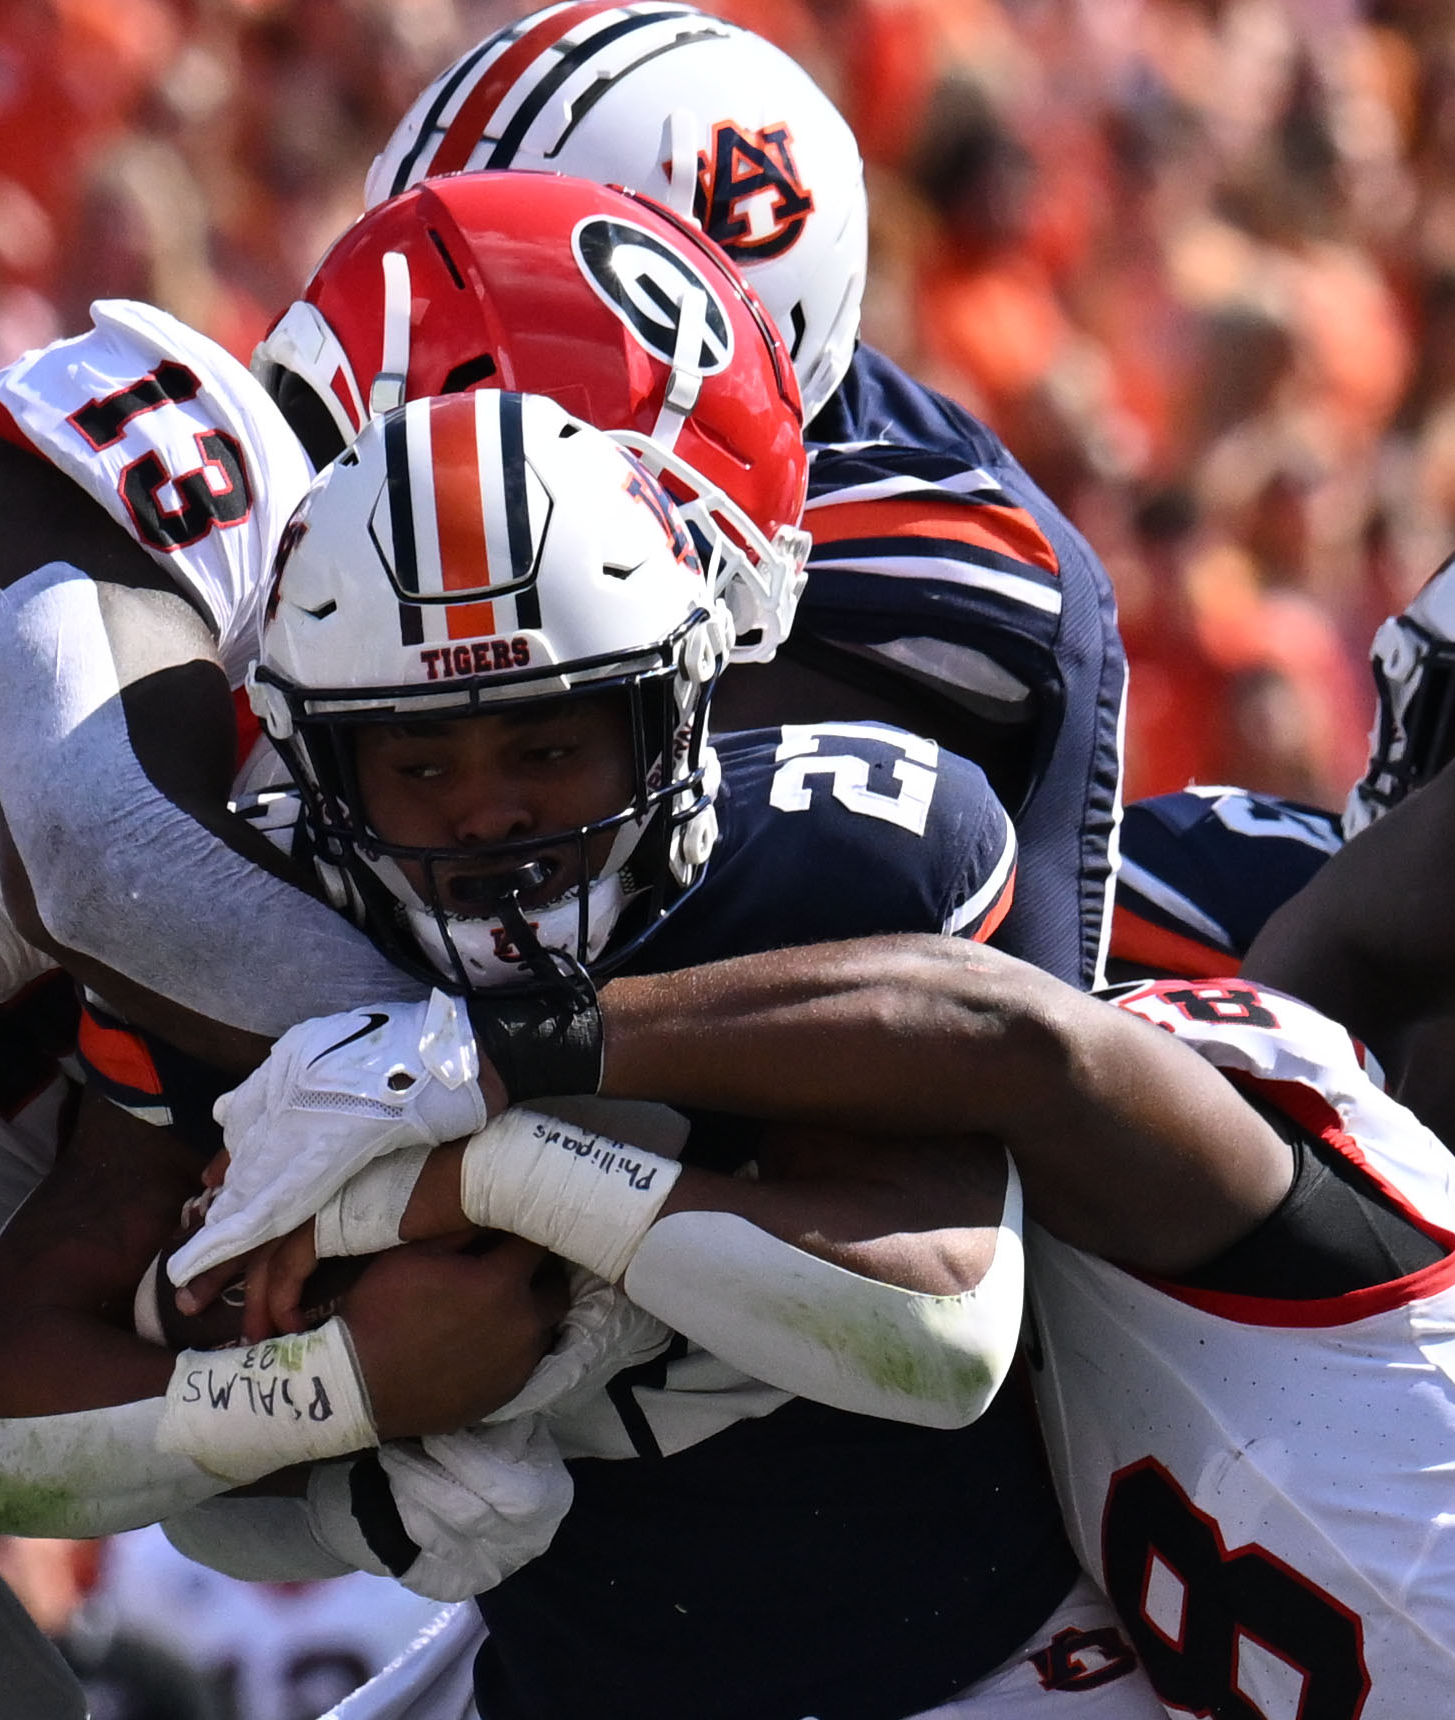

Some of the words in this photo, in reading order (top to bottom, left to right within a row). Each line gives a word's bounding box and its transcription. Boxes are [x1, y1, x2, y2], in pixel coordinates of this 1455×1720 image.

[575, 217, 732, 372] G
[65, 360, 254, 554] 13
[420, 636, 531, 682] TIGERS
[243, 1344, 279, 1371] 23
[182, 1369, 334, 1422] PSALMS
